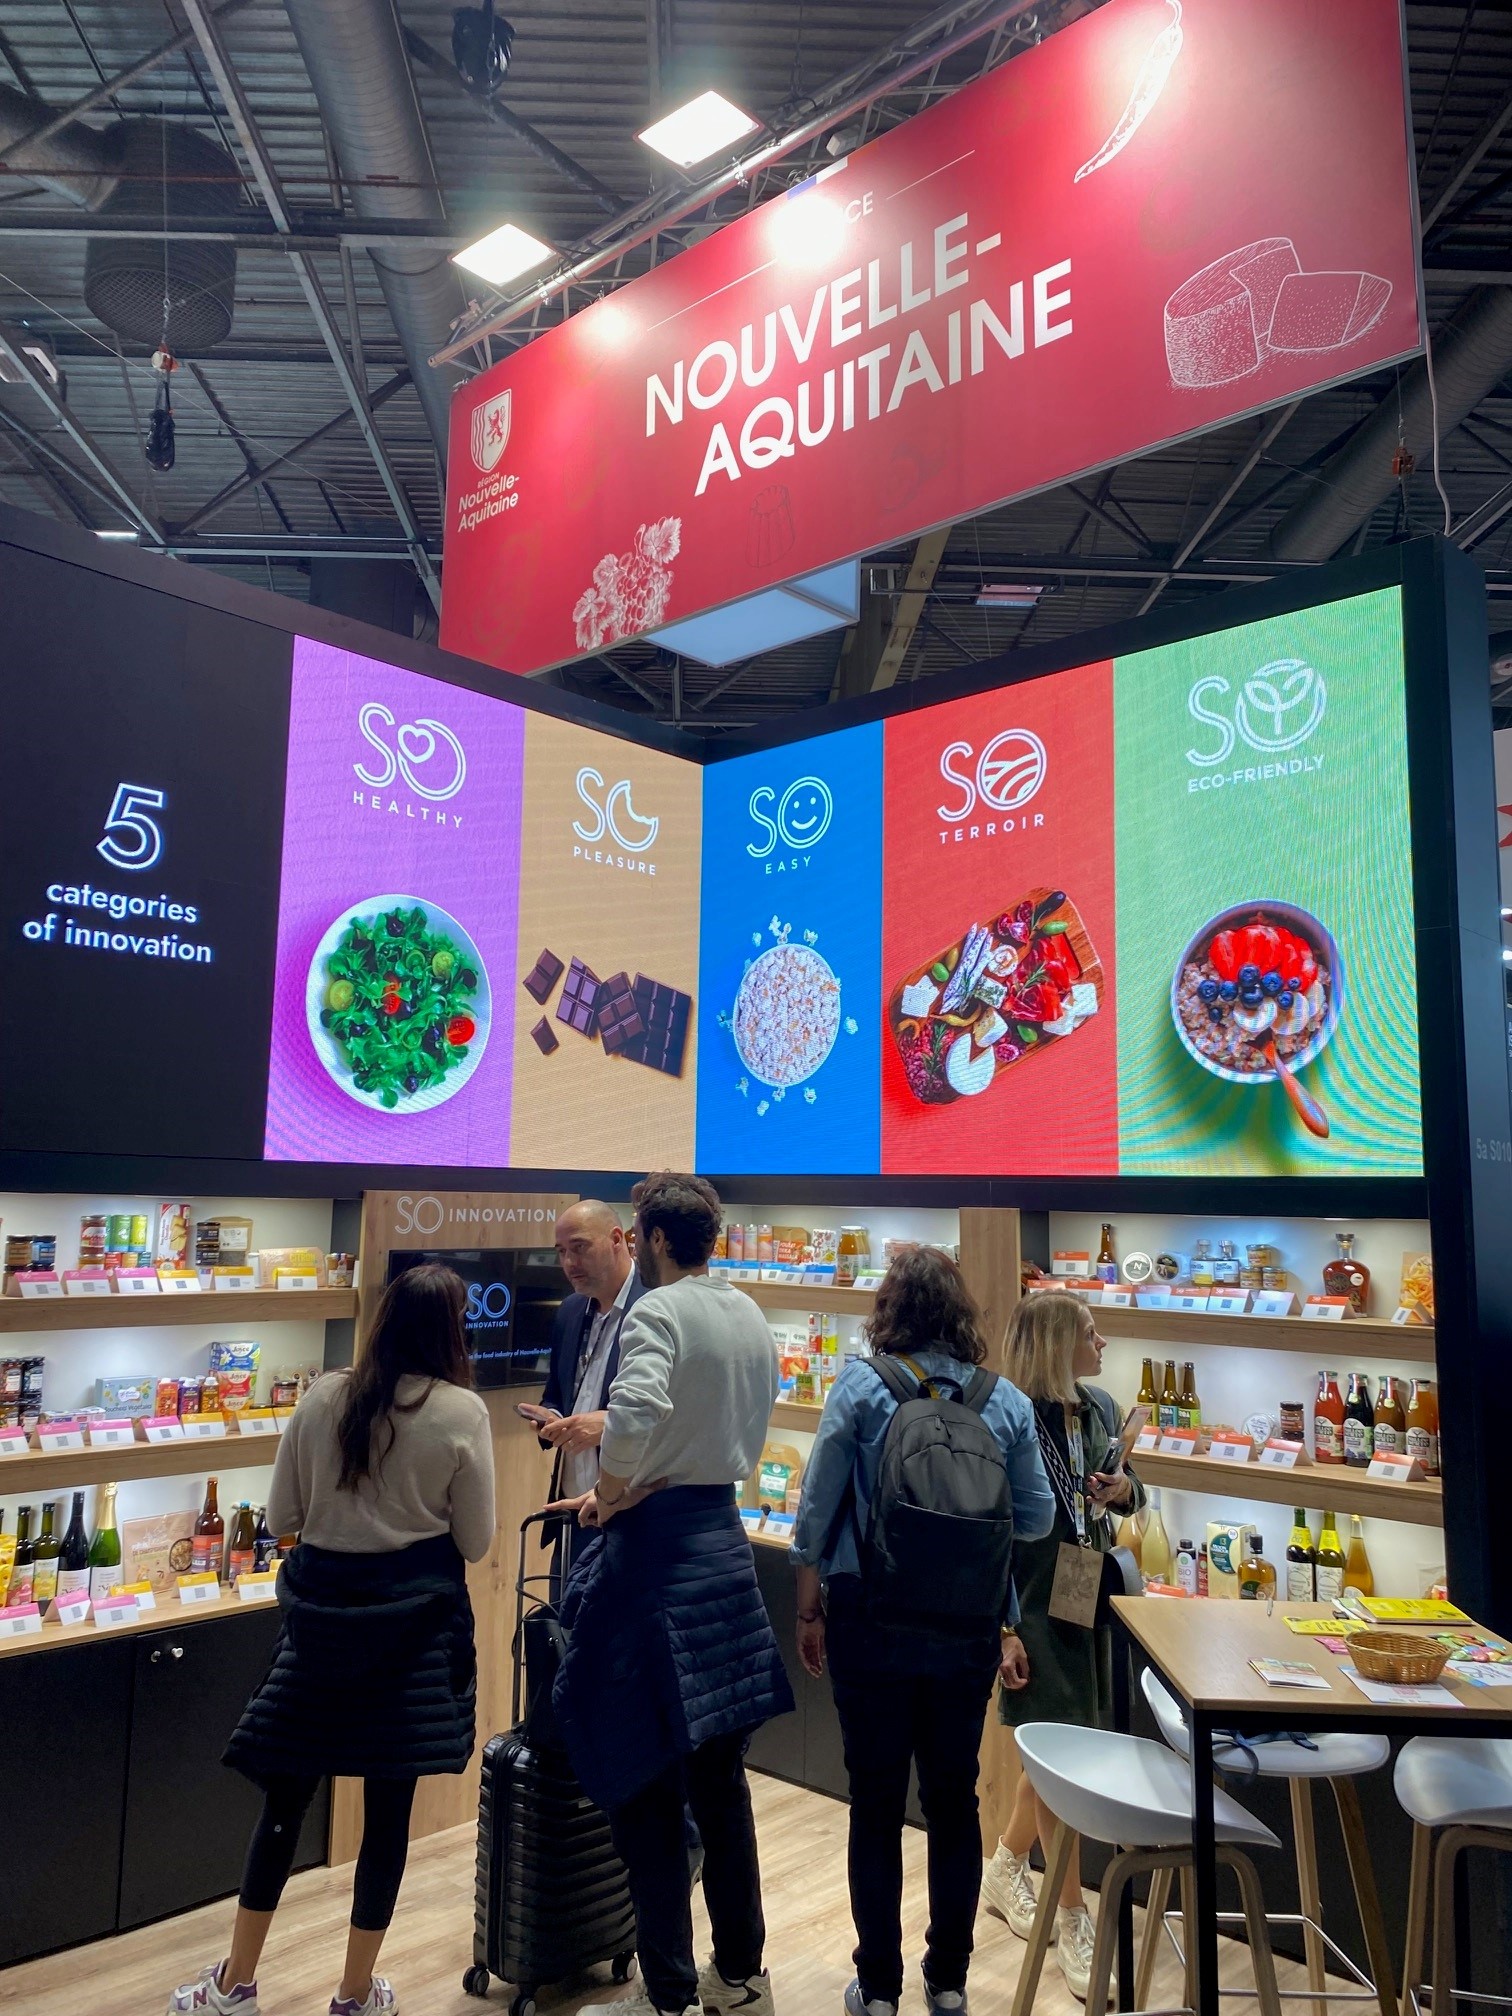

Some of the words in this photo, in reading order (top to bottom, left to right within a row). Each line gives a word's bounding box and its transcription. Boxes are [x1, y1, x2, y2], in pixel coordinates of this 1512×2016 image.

[646, 212, 1001, 437] NOUVELLE-
[694, 258, 1072, 497] AQUITAINE
[458, 492, 519, 533] Aquitaine
[459, 474, 520, 513] Nouvelle-
[1187, 753, 1325, 794] ECO-FRIENDLY
[96, 782, 164, 870] 5
[352, 791, 464, 829] HEALTHY
[938, 812, 1046, 845] TERROIR
[572, 845, 657, 876] PLEASURE
[764, 855, 813, 875] EASY
[46, 882, 197, 925] categories
[22, 916, 55, 944] of
[64, 921, 212, 964] innovation
[394, 1196, 444, 1235] SO
[449, 1208, 557, 1223] INNOVATION
[465, 1282, 511, 1320] SO
[465, 1321, 509, 1329] INNOVATION
[495, 1349, 513, 1357] industry
